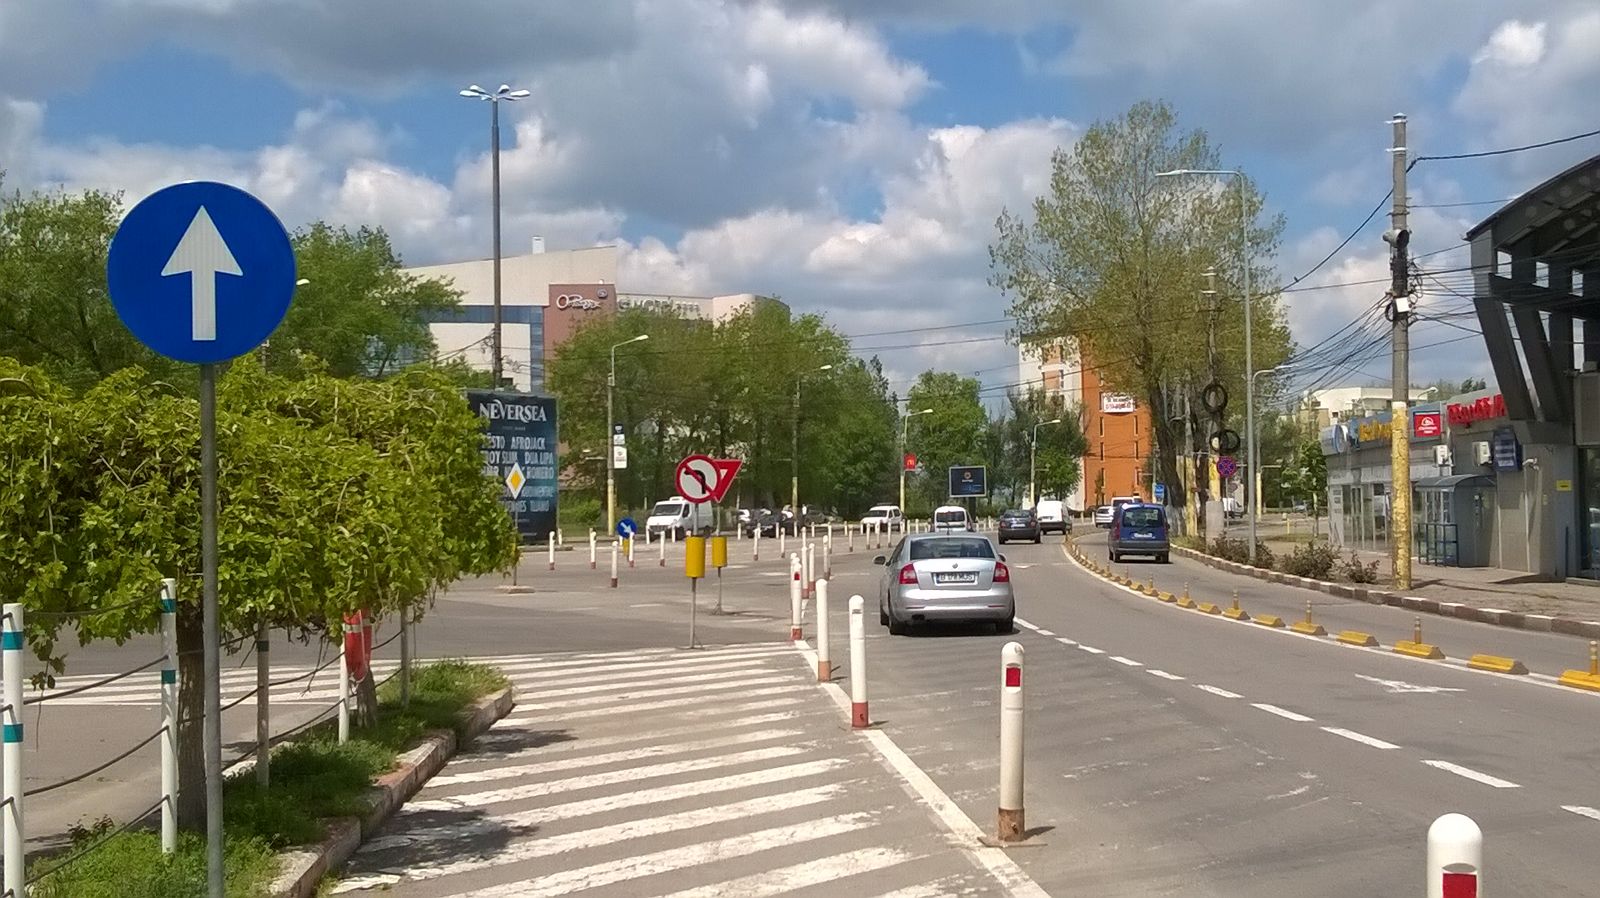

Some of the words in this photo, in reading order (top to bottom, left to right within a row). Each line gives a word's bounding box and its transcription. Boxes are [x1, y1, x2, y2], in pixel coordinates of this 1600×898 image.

[480, 399, 547, 423] NEVERSEA
[511, 436, 545, 449] AFROJACK
[540, 452, 554, 465] LIPA
